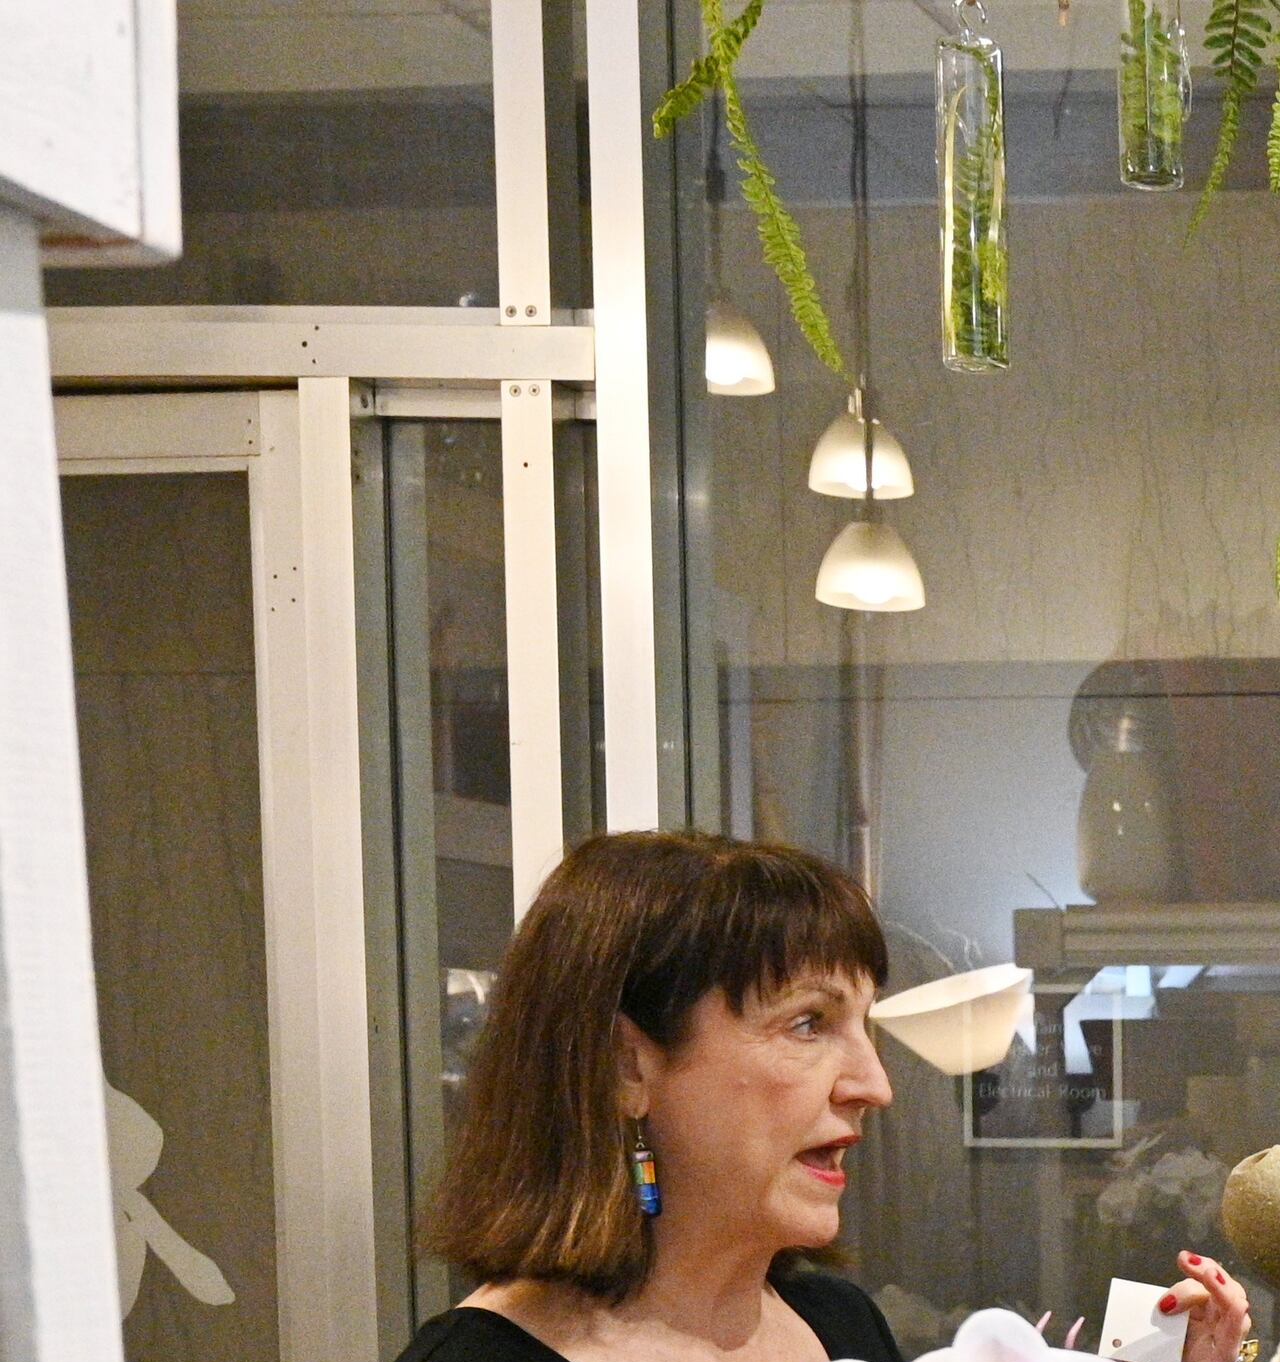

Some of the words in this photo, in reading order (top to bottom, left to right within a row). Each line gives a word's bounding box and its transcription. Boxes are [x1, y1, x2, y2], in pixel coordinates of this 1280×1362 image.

[1026, 1062, 1058, 1078] and
[979, 1083, 1050, 1099] Electrical
[1059, 1083, 1106, 1099] Room
